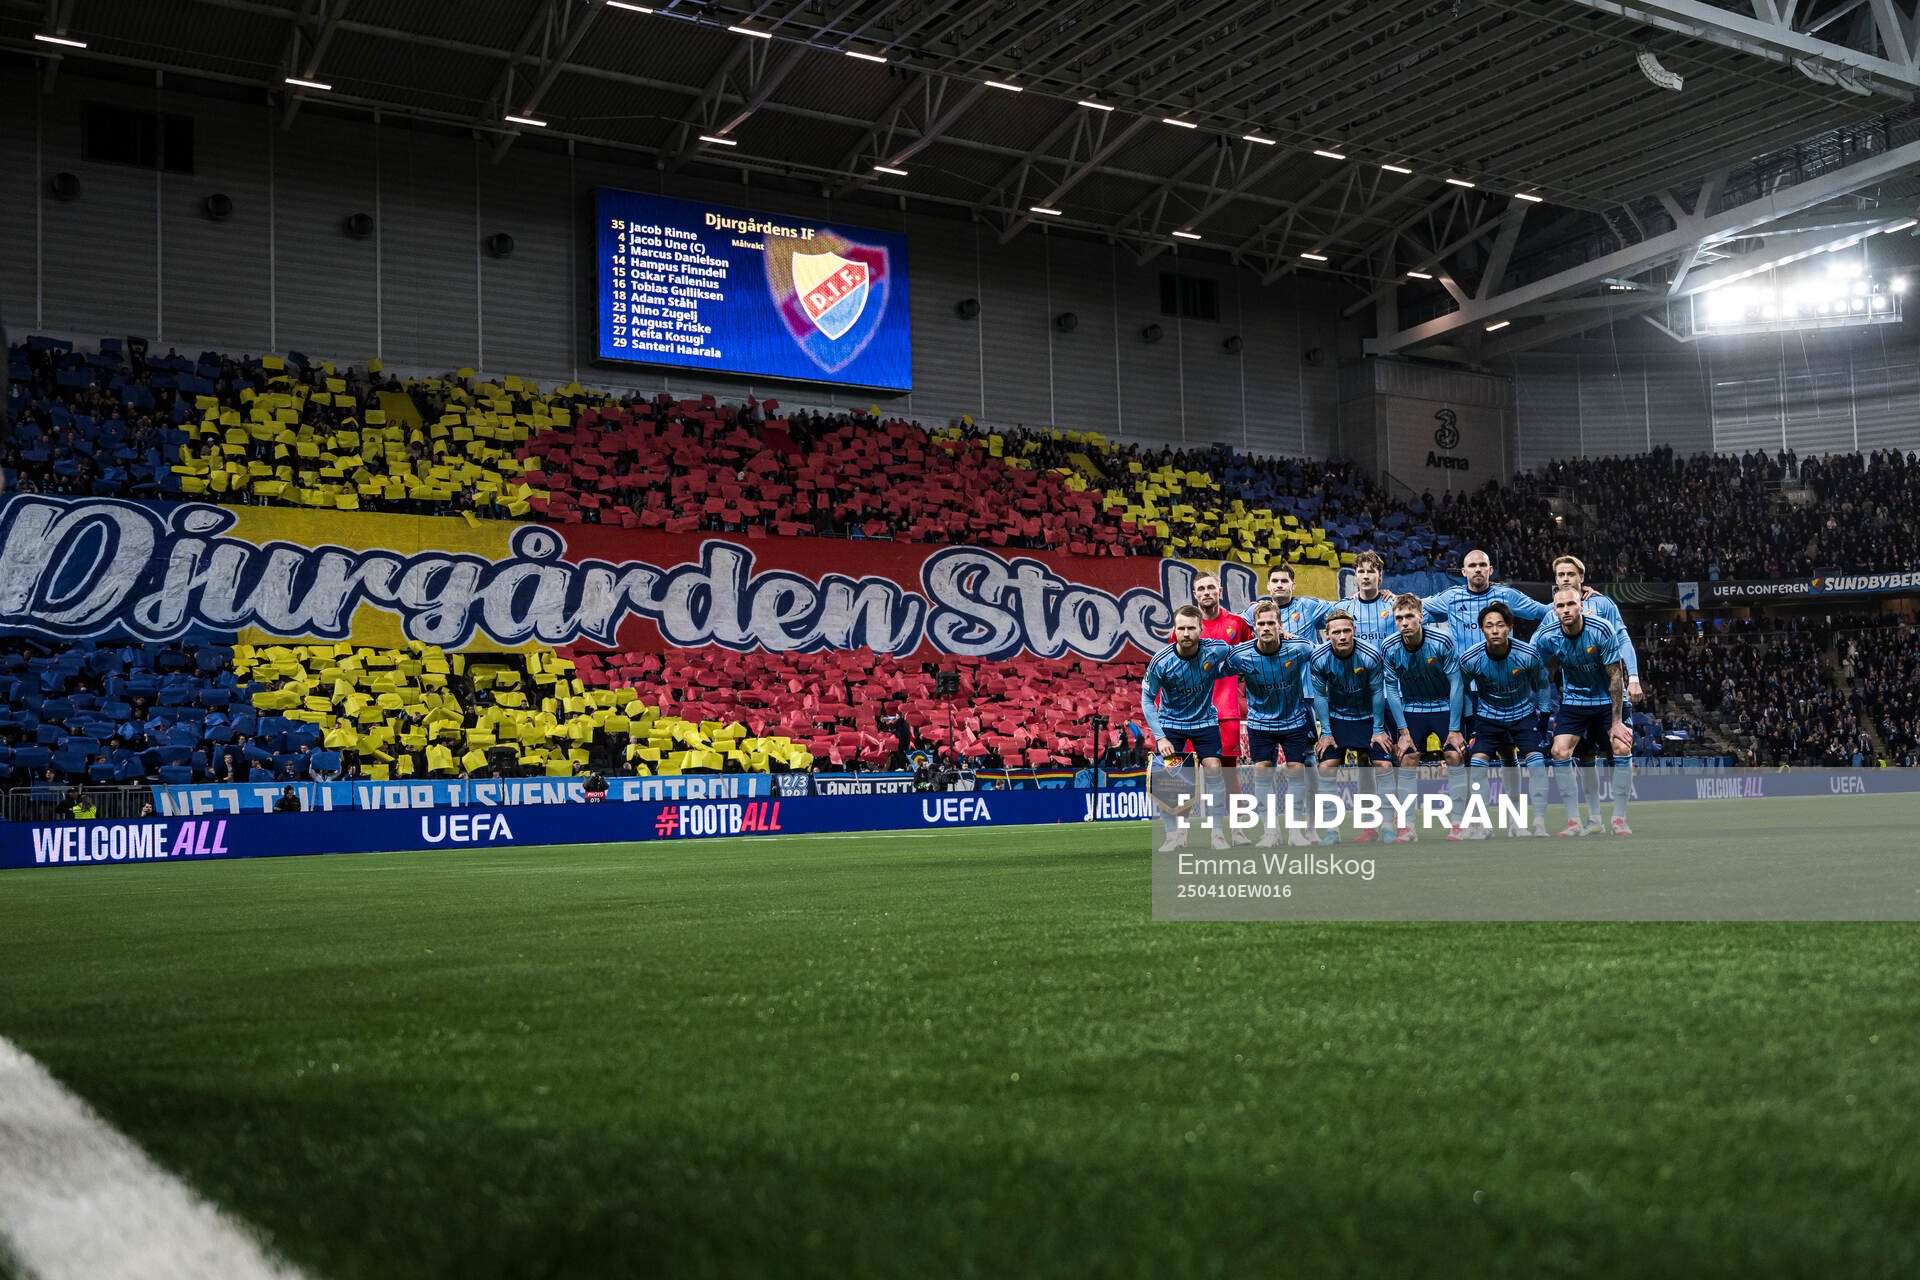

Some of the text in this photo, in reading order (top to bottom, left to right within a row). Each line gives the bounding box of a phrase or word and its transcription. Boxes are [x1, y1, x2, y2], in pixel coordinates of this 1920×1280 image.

[611, 220, 698, 240] 35 Jacob Rinne
[705, 213, 815, 240] Djurgårdens IF
[618, 232, 706, 254] 4 Jacob Une (C)
[732, 239, 764, 250] Målvakt
[612, 254, 726, 278] 14 Hampus Finndell
[618, 244, 729, 268] 3 Marcus Danielson
[612, 266, 720, 289] 15 Oskar Fallenius
[612, 278, 724, 301] 16 Tobias Gulliksen
[613, 290, 698, 310] 18 Adam Ståhl
[809, 269, 861, 310] D.I.F.
[613, 302, 698, 322] 23 Nino Zugelj
[613, 314, 712, 334] 26 August Priske
[613, 326, 704, 346] 27 Keita Kosugi
[613, 338, 722, 358] 29 Santeri Haarala
[1434, 408, 1460, 450] 3
[1426, 452, 1469, 470] Arena
[0, 495, 926, 656] Djurgården
[1713, 584, 1809, 596] UEFA CONFEREN
[778, 775, 808, 787] 12/3
[1696, 776, 1764, 799] WELCOME ALL
[1830, 776, 1866, 794] UEFA
[476, 782, 608, 806] SVENS
[654, 801, 782, 836] #FOOTBALL
[923, 797, 992, 822] UEFA
[422, 813, 514, 843] UEFA
[32, 820, 228, 862] WELCOME ALL
